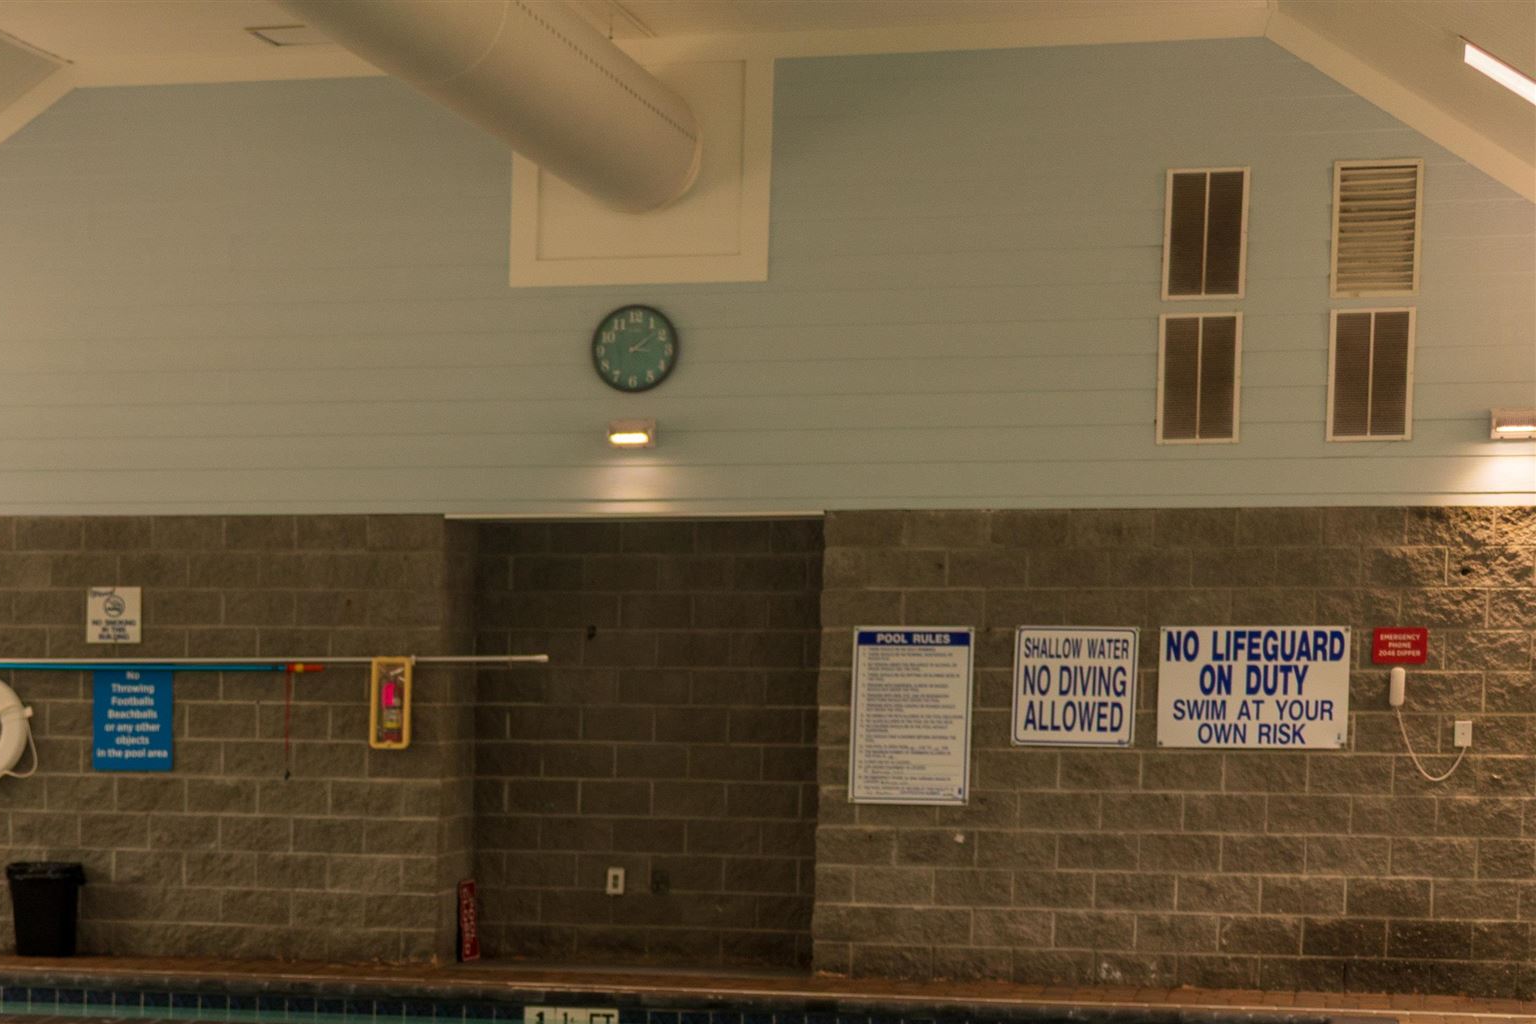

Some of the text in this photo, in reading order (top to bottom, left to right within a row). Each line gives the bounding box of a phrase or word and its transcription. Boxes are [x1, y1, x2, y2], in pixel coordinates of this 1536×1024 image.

[876, 633, 951, 644] POOL RULES
[1166, 630, 1346, 662] NO LIFEGUARD
[1024, 637, 1130, 660] SHALLOW WATER
[1023, 665, 1127, 697] NO DIVING
[1199, 664, 1309, 696] ON DUTY
[111, 683, 155, 695] Throwing
[111, 696, 155, 706] Footballs
[107, 709, 158, 719] Beachballs
[1023, 700, 1124, 733] ALLOWED
[1172, 699, 1334, 721] SWIM AT YOUR
[104, 722, 161, 734] or any other
[1197, 723, 1306, 744] OWN RISK
[115, 735, 150, 746] objects
[107, 748, 123, 757] the
[124, 748, 146, 759] pool
[147, 750, 168, 758] area
